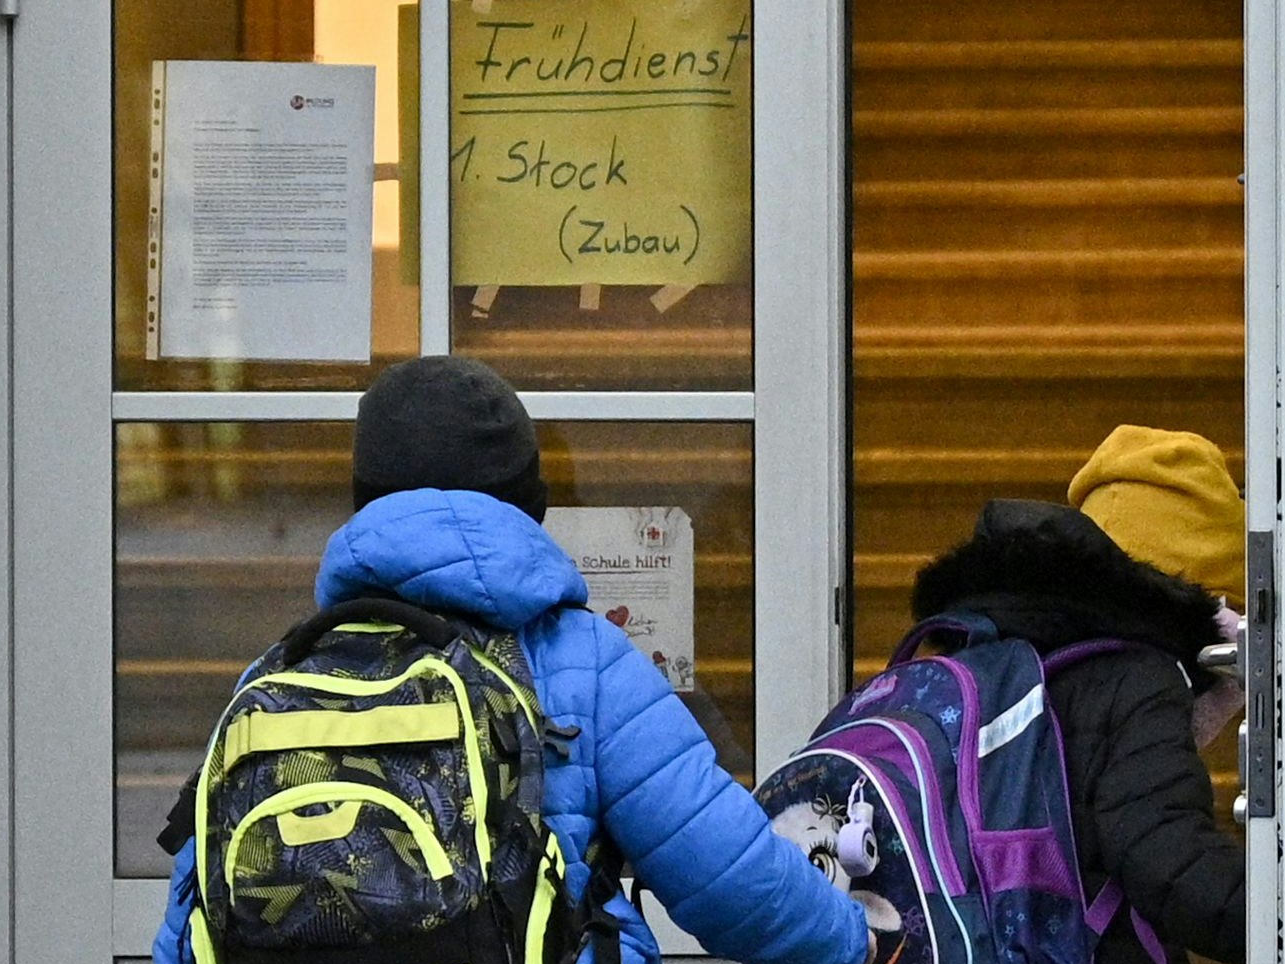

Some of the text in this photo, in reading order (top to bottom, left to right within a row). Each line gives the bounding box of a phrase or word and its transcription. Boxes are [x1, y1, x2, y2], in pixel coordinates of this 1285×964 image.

[475, 14, 750, 84] Frühdienst
[496, 135, 629, 192] Stock
[557, 204, 701, 265] (Zubau)
[582, 555, 630, 569] Schule
[635, 555, 672, 569] hilft!
